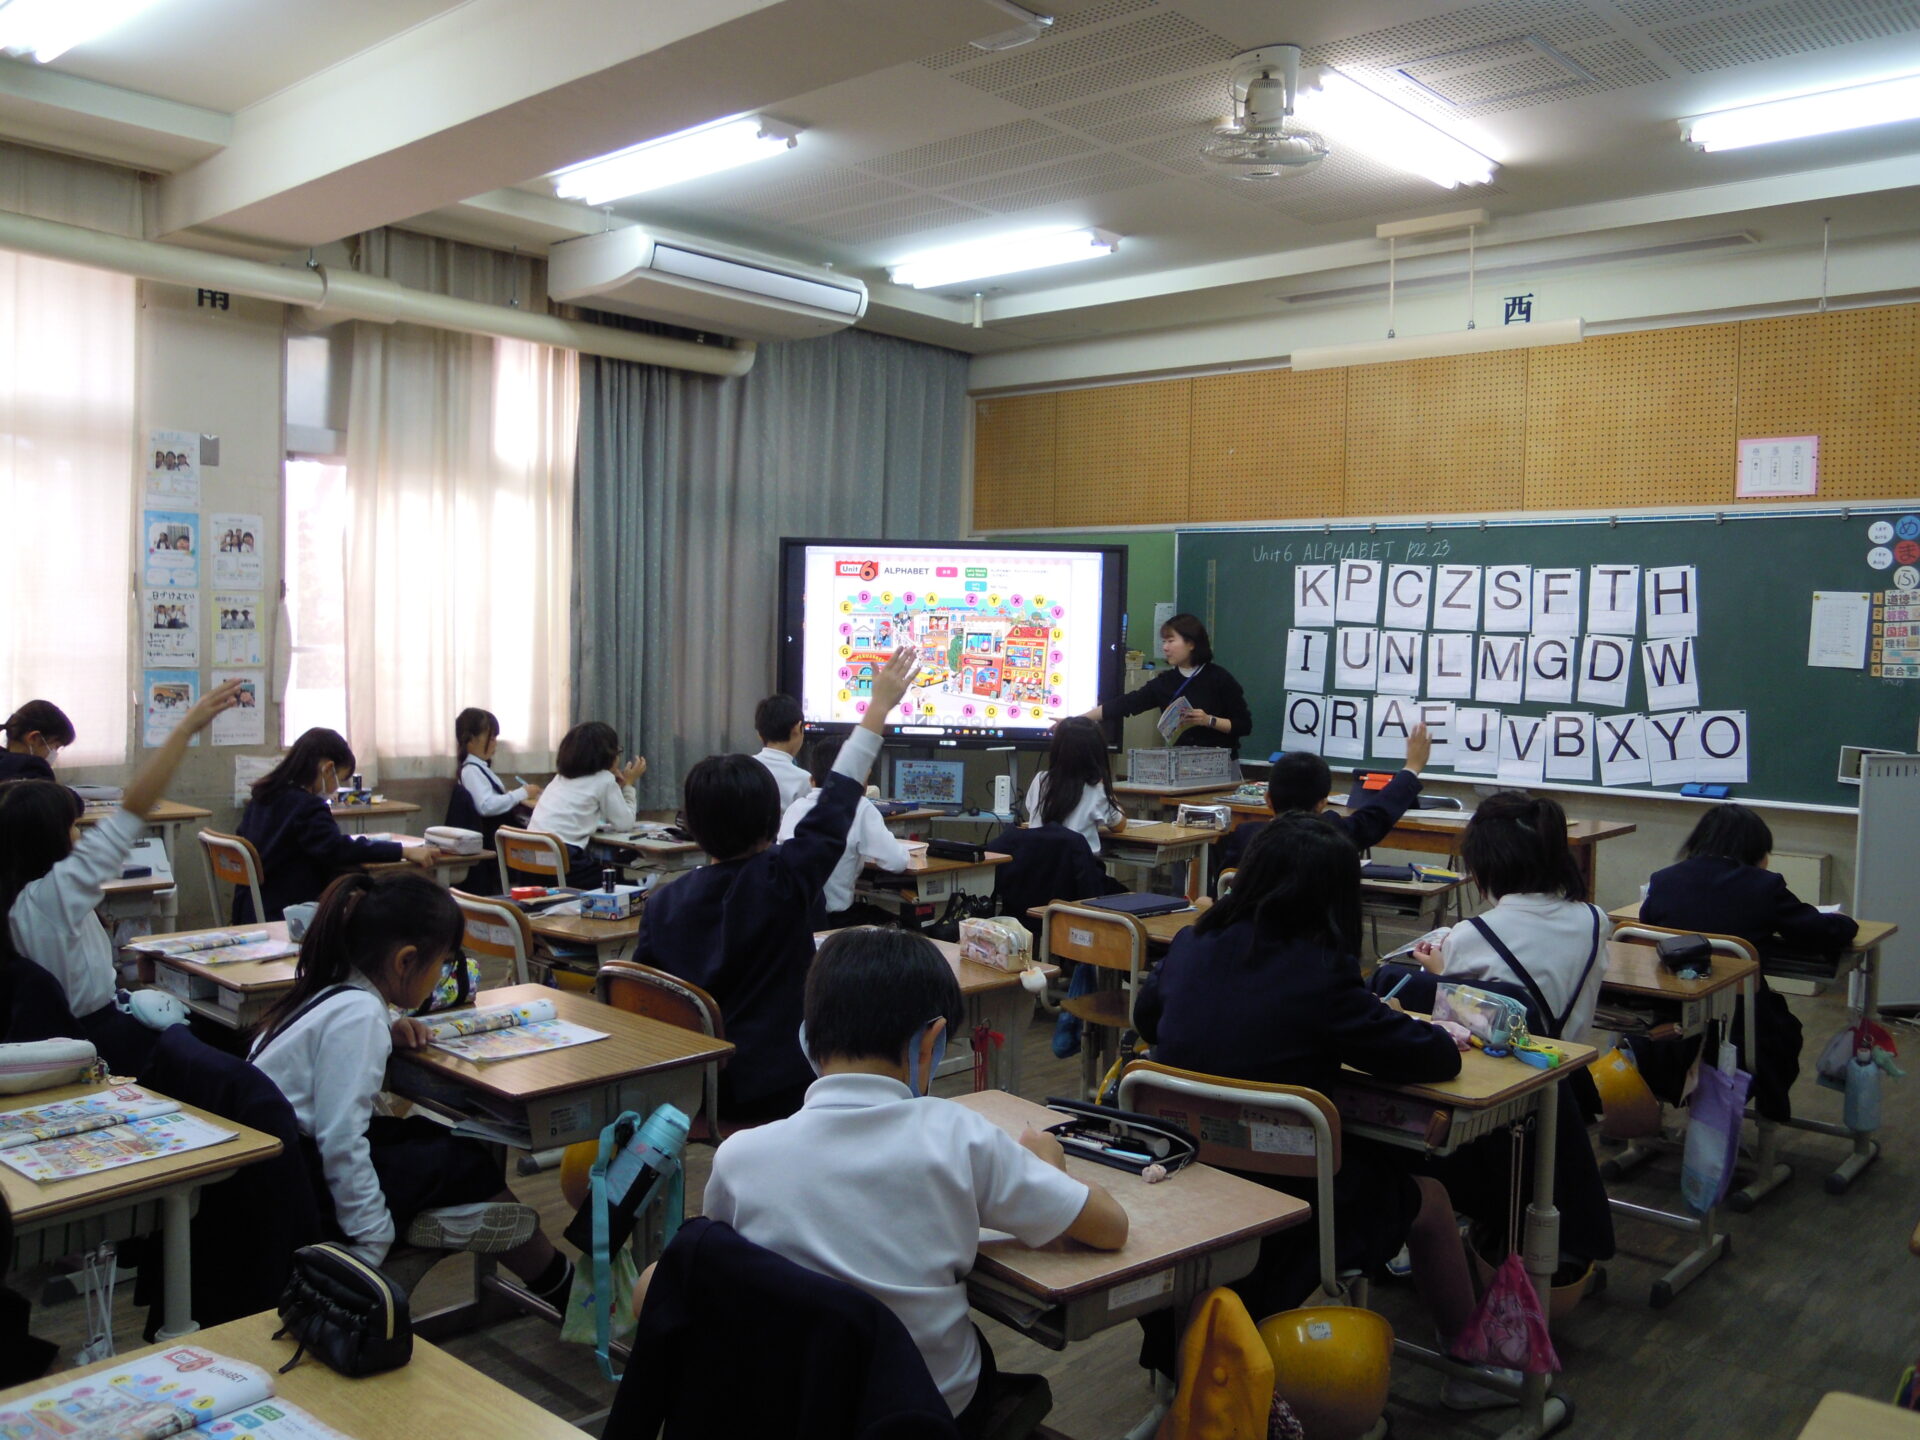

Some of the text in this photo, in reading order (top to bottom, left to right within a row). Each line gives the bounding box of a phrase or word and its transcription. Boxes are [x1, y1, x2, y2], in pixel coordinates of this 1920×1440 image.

[1504, 292, 1534, 325] 西
[1899, 519, 1918, 536] め
[1252, 543, 1281, 562] Unit
[1282, 543, 1293, 562] 6
[1302, 541, 1395, 561] ALPHABET
[842, 560, 930, 581] Unit 6 ALPHABET
[1897, 569, 1916, 586] ふ
[1302, 564, 1688, 615] K P C Z S F T H
[1887, 626, 1908, 637] 国語
[1885, 639, 1905, 649] 理科
[1301, 632, 1689, 687] I U N L M G D W
[1884, 666, 1905, 676] 総合
[1289, 698, 1741, 762] Q R A E J V B X Y O
